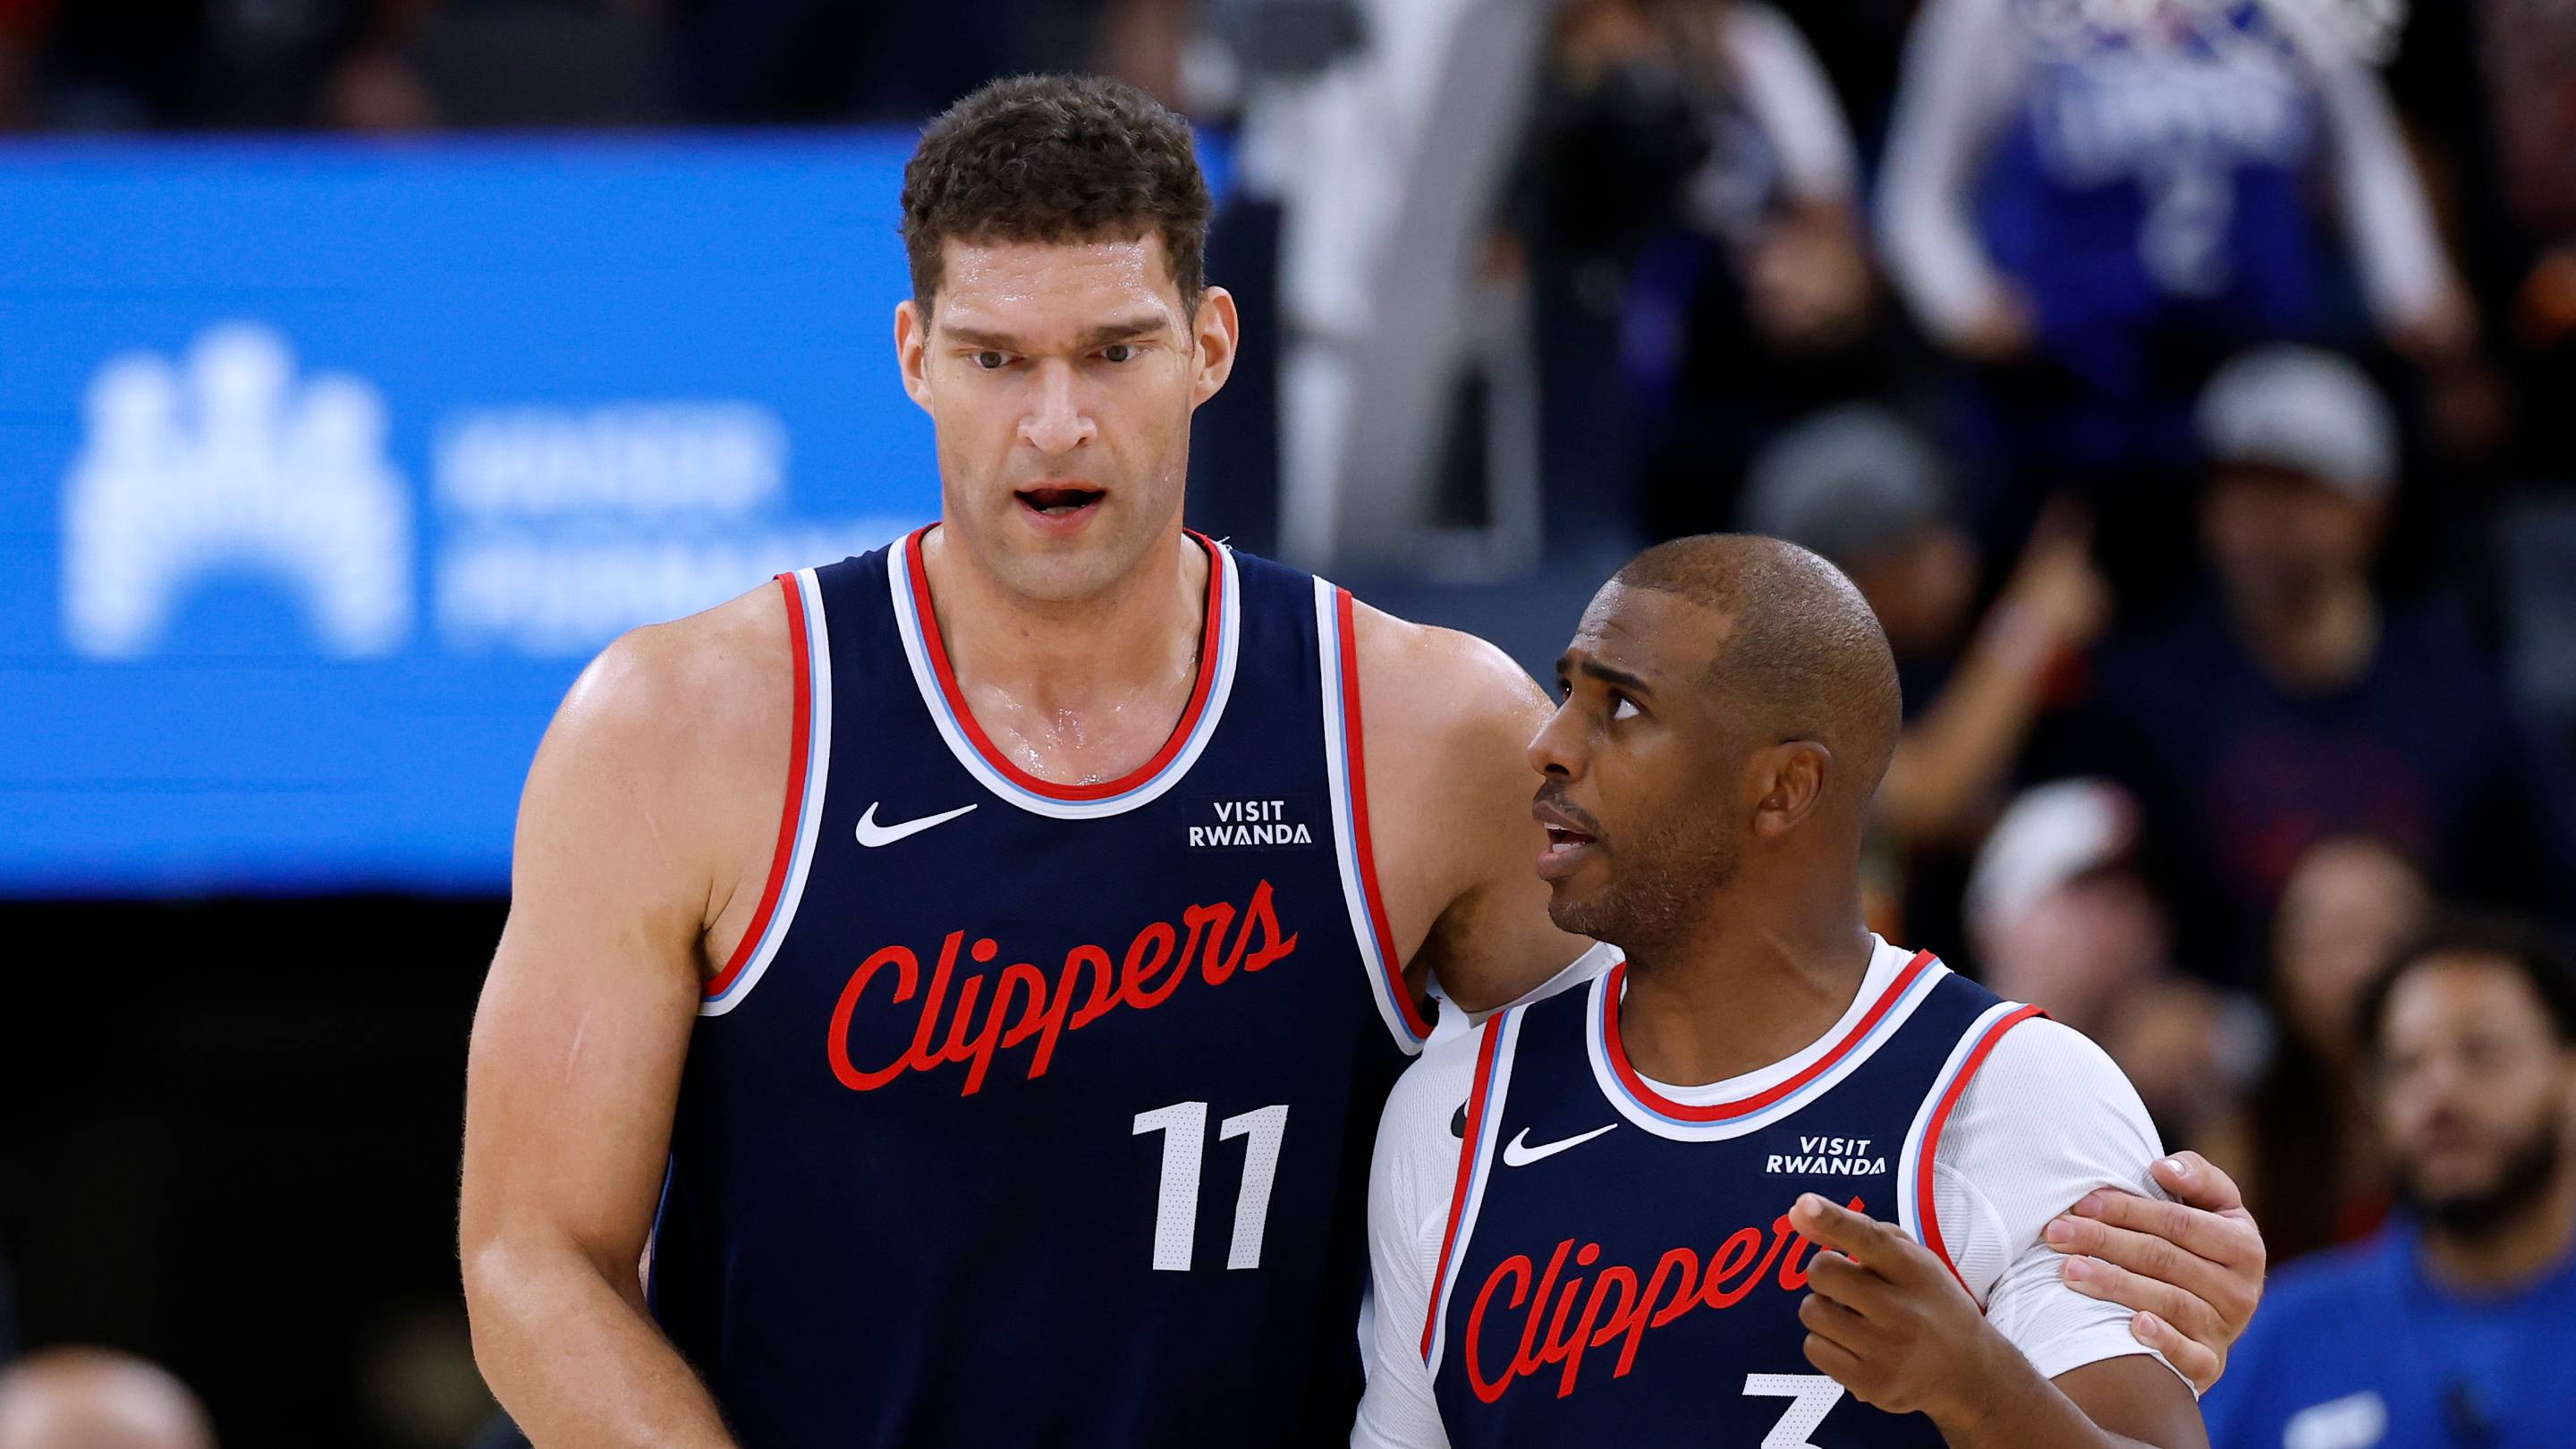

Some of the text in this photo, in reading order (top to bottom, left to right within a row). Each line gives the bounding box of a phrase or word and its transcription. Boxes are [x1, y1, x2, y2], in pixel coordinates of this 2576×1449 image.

[1213, 801, 1284, 822] VISIT
[1189, 823, 1312, 847] RWANDA
[827, 878, 1299, 1097] Clippers
[1800, 1136, 1871, 1157] VISIT
[1766, 1154, 1886, 1175] RWANDA
[1132, 1101, 1290, 1271] 11
[1465, 1195, 1866, 1403] Clipper
